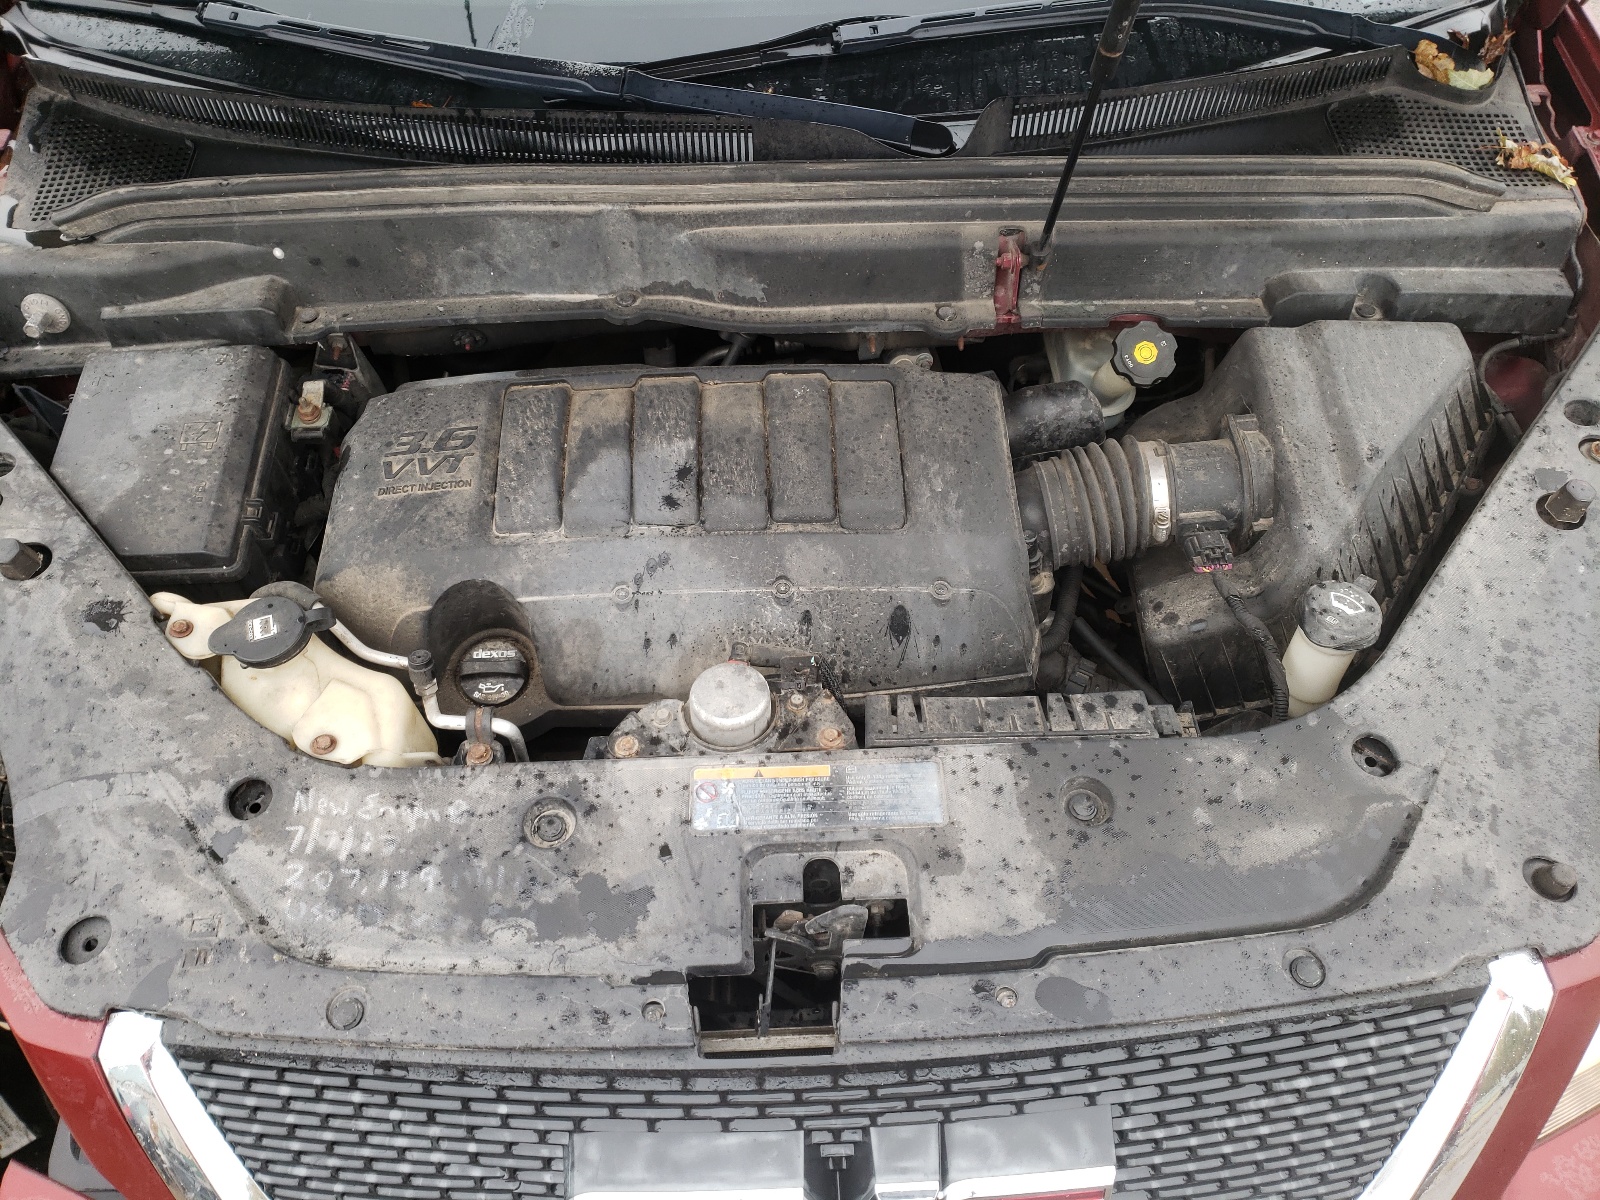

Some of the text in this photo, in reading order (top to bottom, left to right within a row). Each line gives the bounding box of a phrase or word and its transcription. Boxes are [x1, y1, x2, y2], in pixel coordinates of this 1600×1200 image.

[384, 425, 479, 458] 3.6
[382, 453, 475, 480] VVT
[377, 479, 472, 497] DIRECT INJECTION
[472, 649, 517, 659] dexos
[294, 788, 349, 815] New
